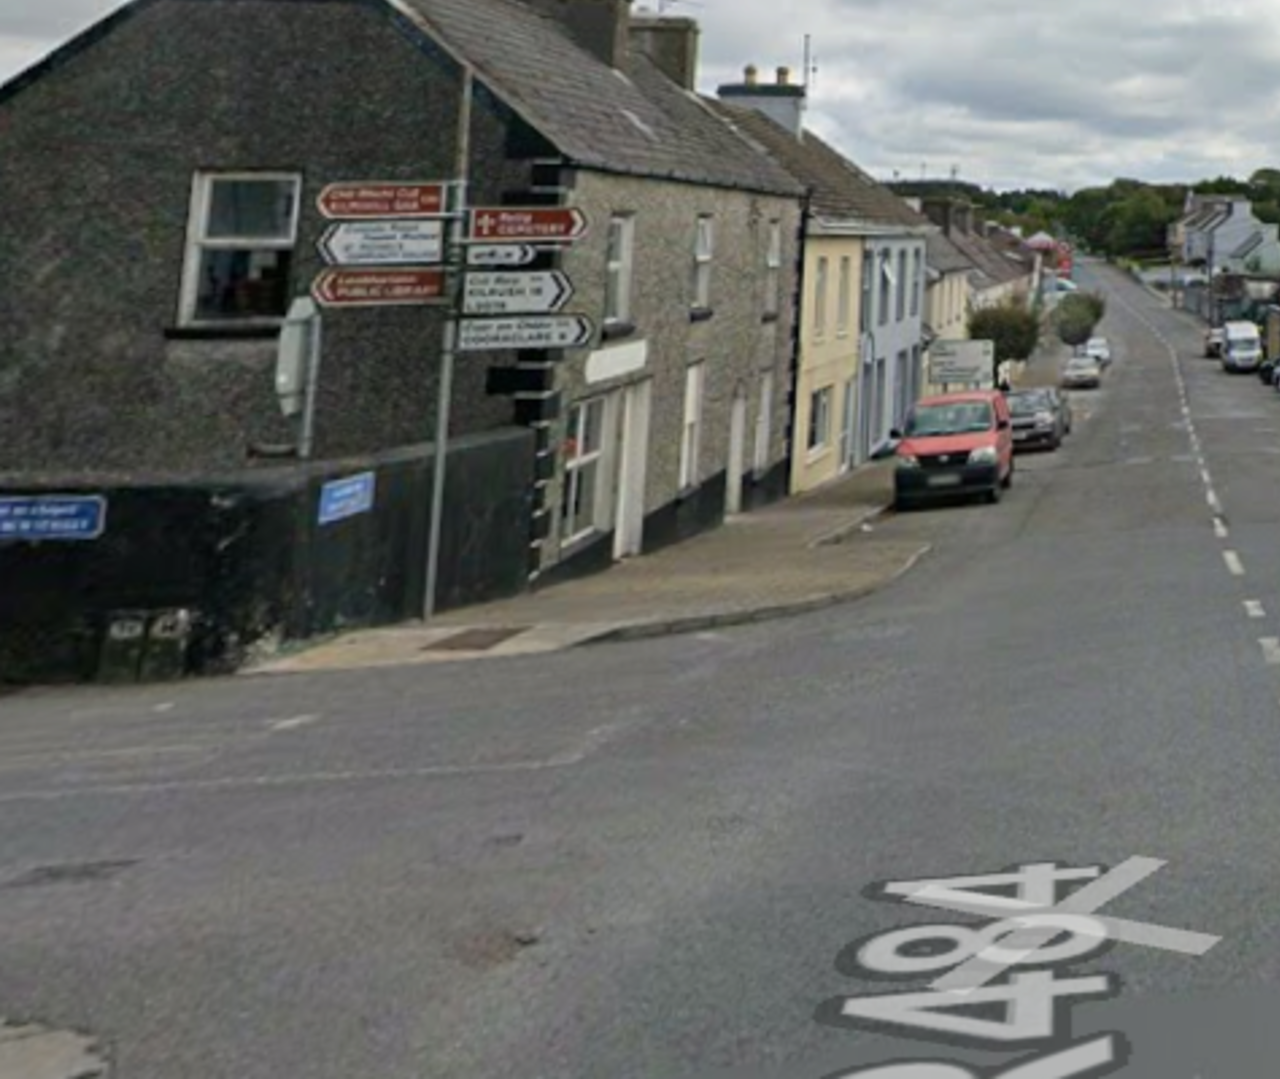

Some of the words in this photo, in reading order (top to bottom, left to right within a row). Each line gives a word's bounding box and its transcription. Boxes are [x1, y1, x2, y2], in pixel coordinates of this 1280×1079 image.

[497, 223, 566, 236] CEMETERY
[337, 287, 382, 297] PUBLIC
[385, 285, 438, 296] LIBRARY
[468, 287, 526, 297] KILRUSH
